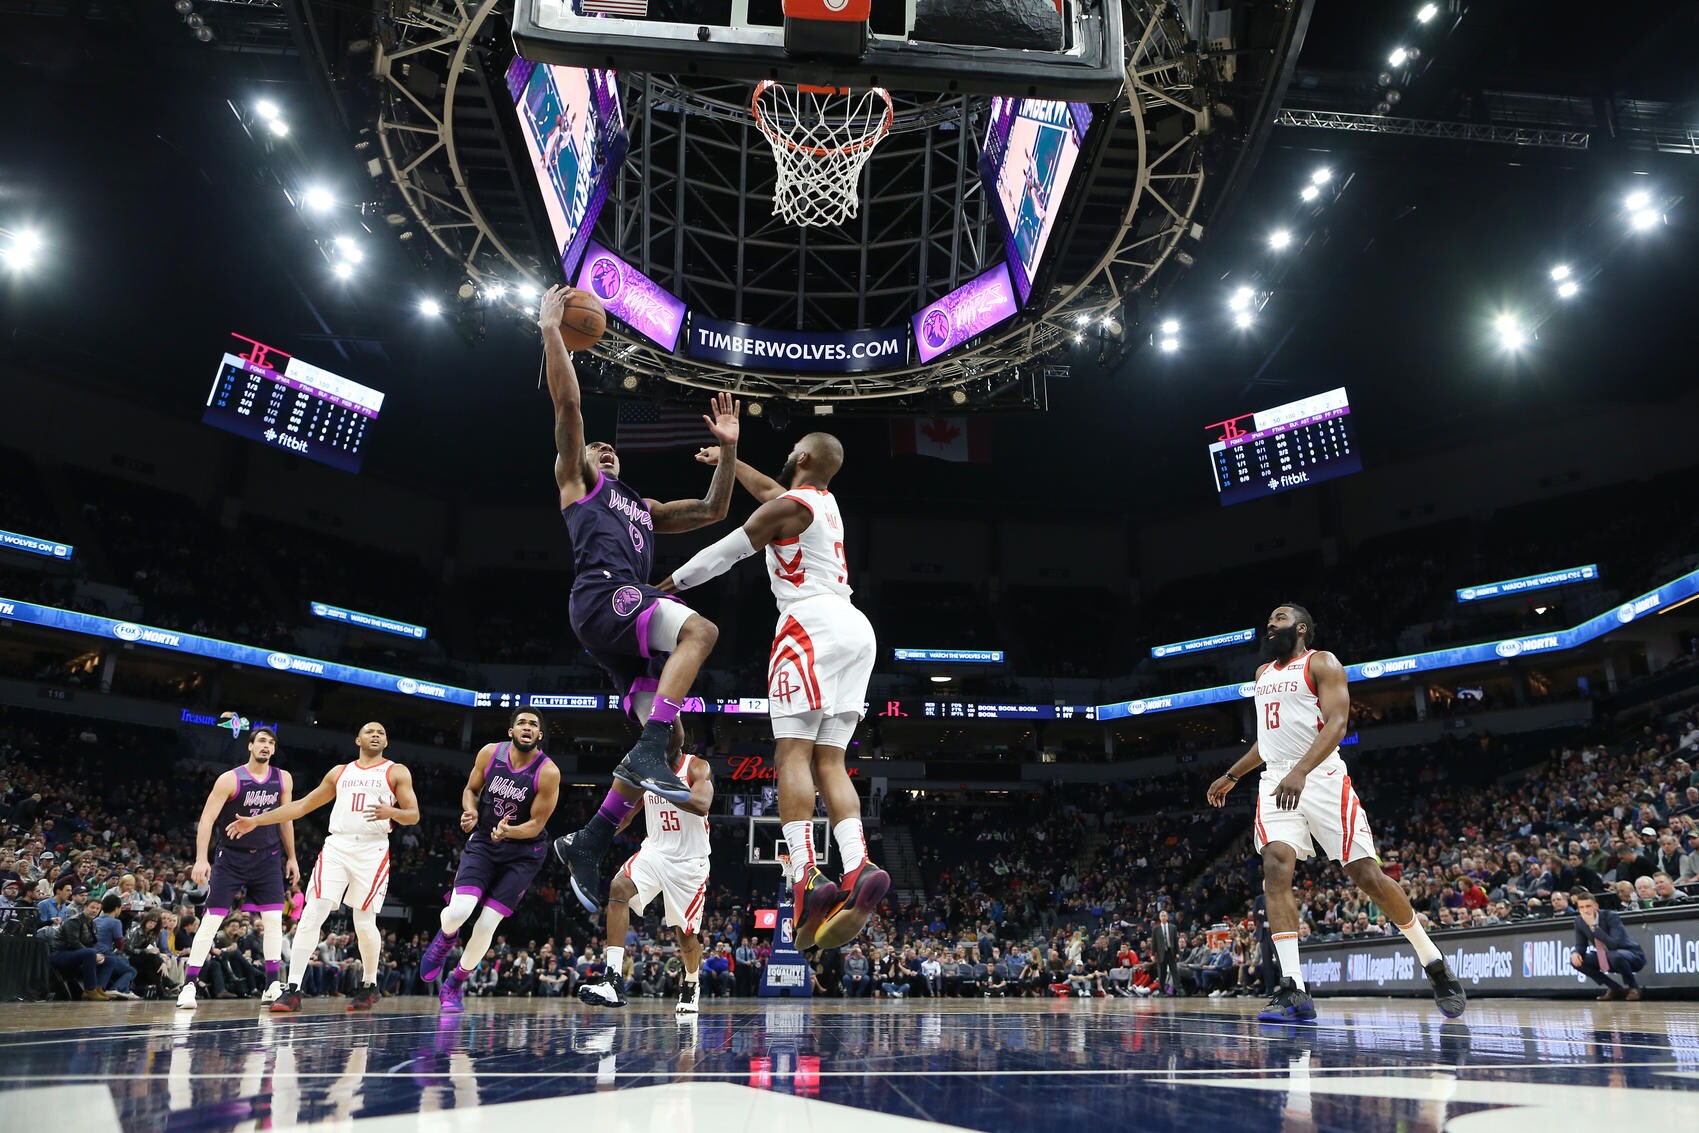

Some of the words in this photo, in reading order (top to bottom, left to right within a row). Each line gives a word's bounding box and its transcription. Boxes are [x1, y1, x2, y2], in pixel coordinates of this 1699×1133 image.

[698, 328, 899, 360] TIMBERWOLVES.COM
[4, 536, 38, 549] WOLVES
[38, 543, 52, 552] ON
[1256, 681, 1298, 696] ROCKETS
[749, 701, 761, 709] 12
[1264, 702, 1280, 730] 13
[342, 780, 382, 788] ROCKETS
[488, 775, 528, 802] Wolves
[352, 793, 366, 812] 10
[494, 798, 517, 820] 32
[660, 811, 680, 831] 35
[1534, 941, 1556, 976] NBA
[768, 968, 801, 976] EQUALITY
[1354, 953, 1366, 981] NBA
[1367, 952, 1393, 986] League
[1394, 952, 1415, 980] Pass
